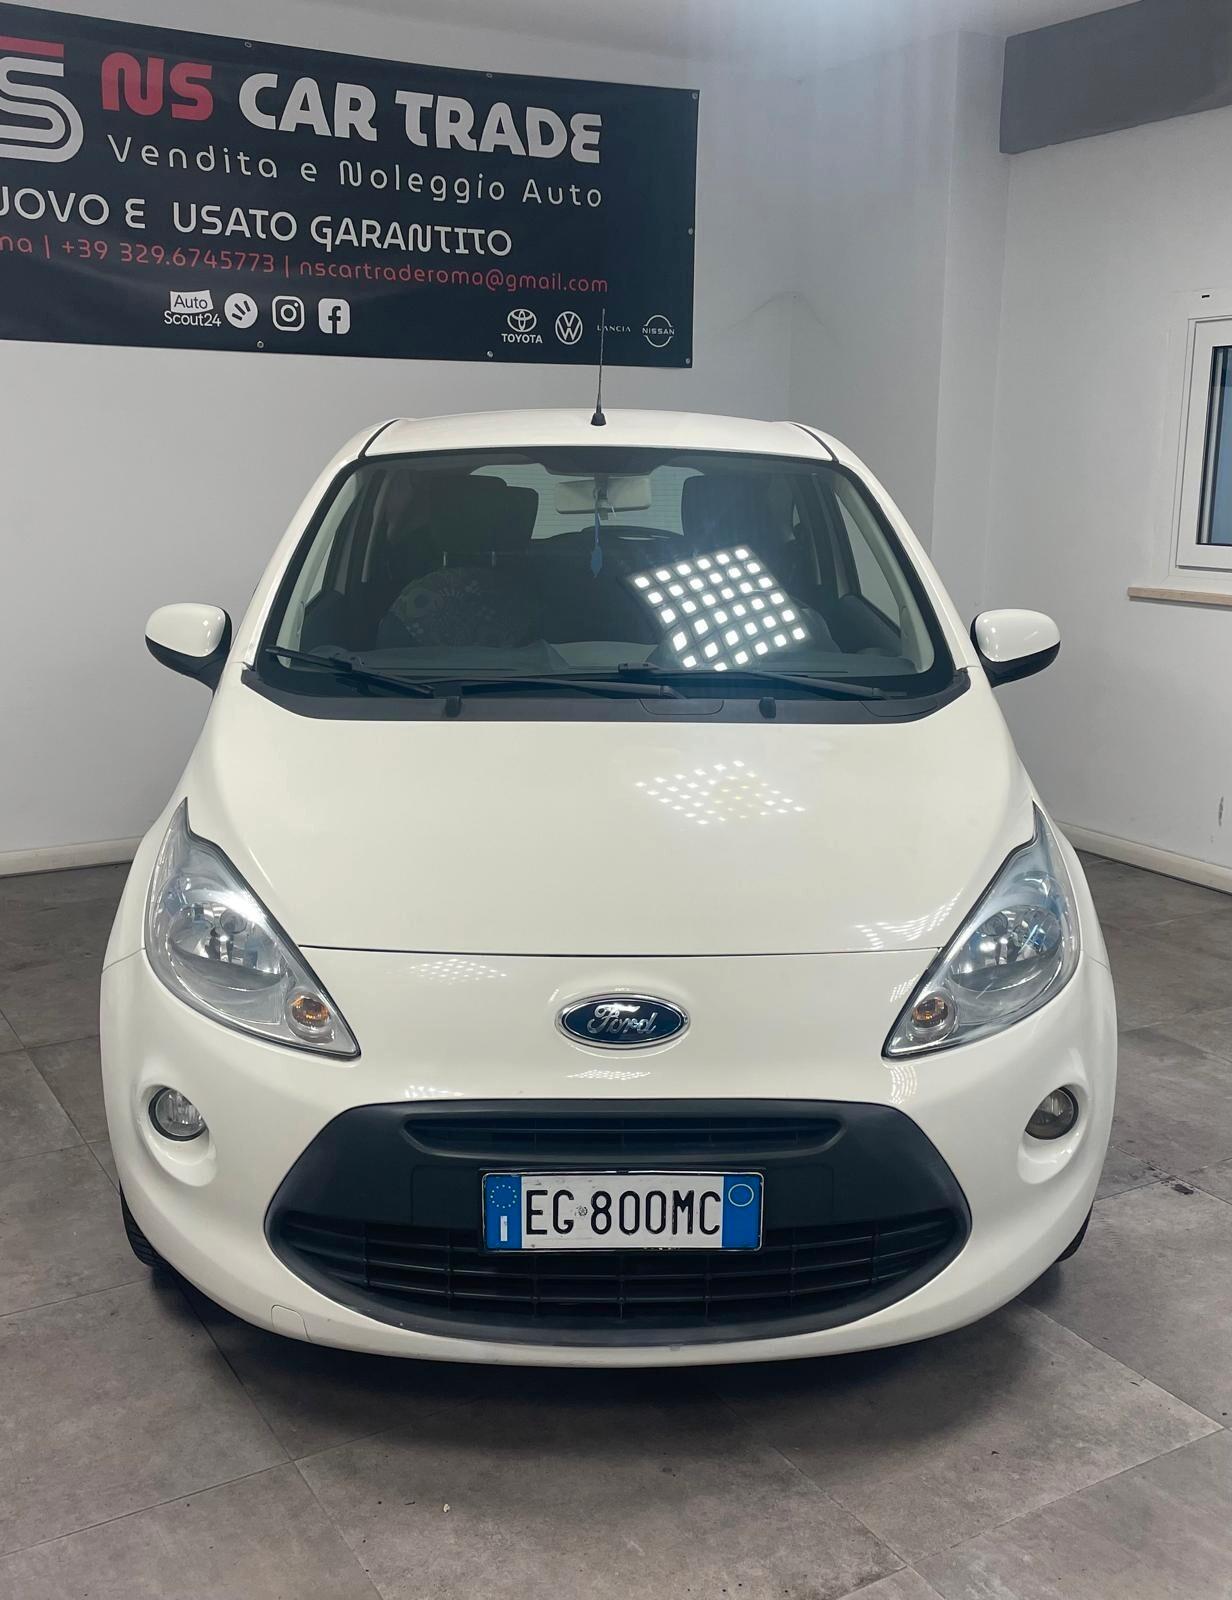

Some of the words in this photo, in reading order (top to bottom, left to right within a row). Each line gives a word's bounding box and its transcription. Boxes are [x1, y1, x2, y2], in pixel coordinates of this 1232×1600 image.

[101, 52, 214, 121] NS
[238, 73, 378, 142] CAR
[395, 89, 603, 164] TRADE
[107, 134, 278, 178] Vendita
[300, 162, 317, 182] e
[340, 160, 505, 204] Noleggio
[522, 178, 602, 208] Auto
[173, 201, 297, 241] USATO
[310, 215, 512, 256] GARANTITO
[62, 239, 108, 260] +39
[120, 242, 274, 273] 329.6745773
[300, 260, 608, 293] nscartraderoma@gmail.com
[164, 310, 221, 327] Scout24
[174, 294, 208, 310] Auto
[501, 333, 543, 344] TOYOTA
[642, 327, 675, 335] NISSAN
[587, 1003, 658, 1034] Ford
[526, 1189, 574, 1235] EG
[590, 1190, 721, 1235] 800MC
